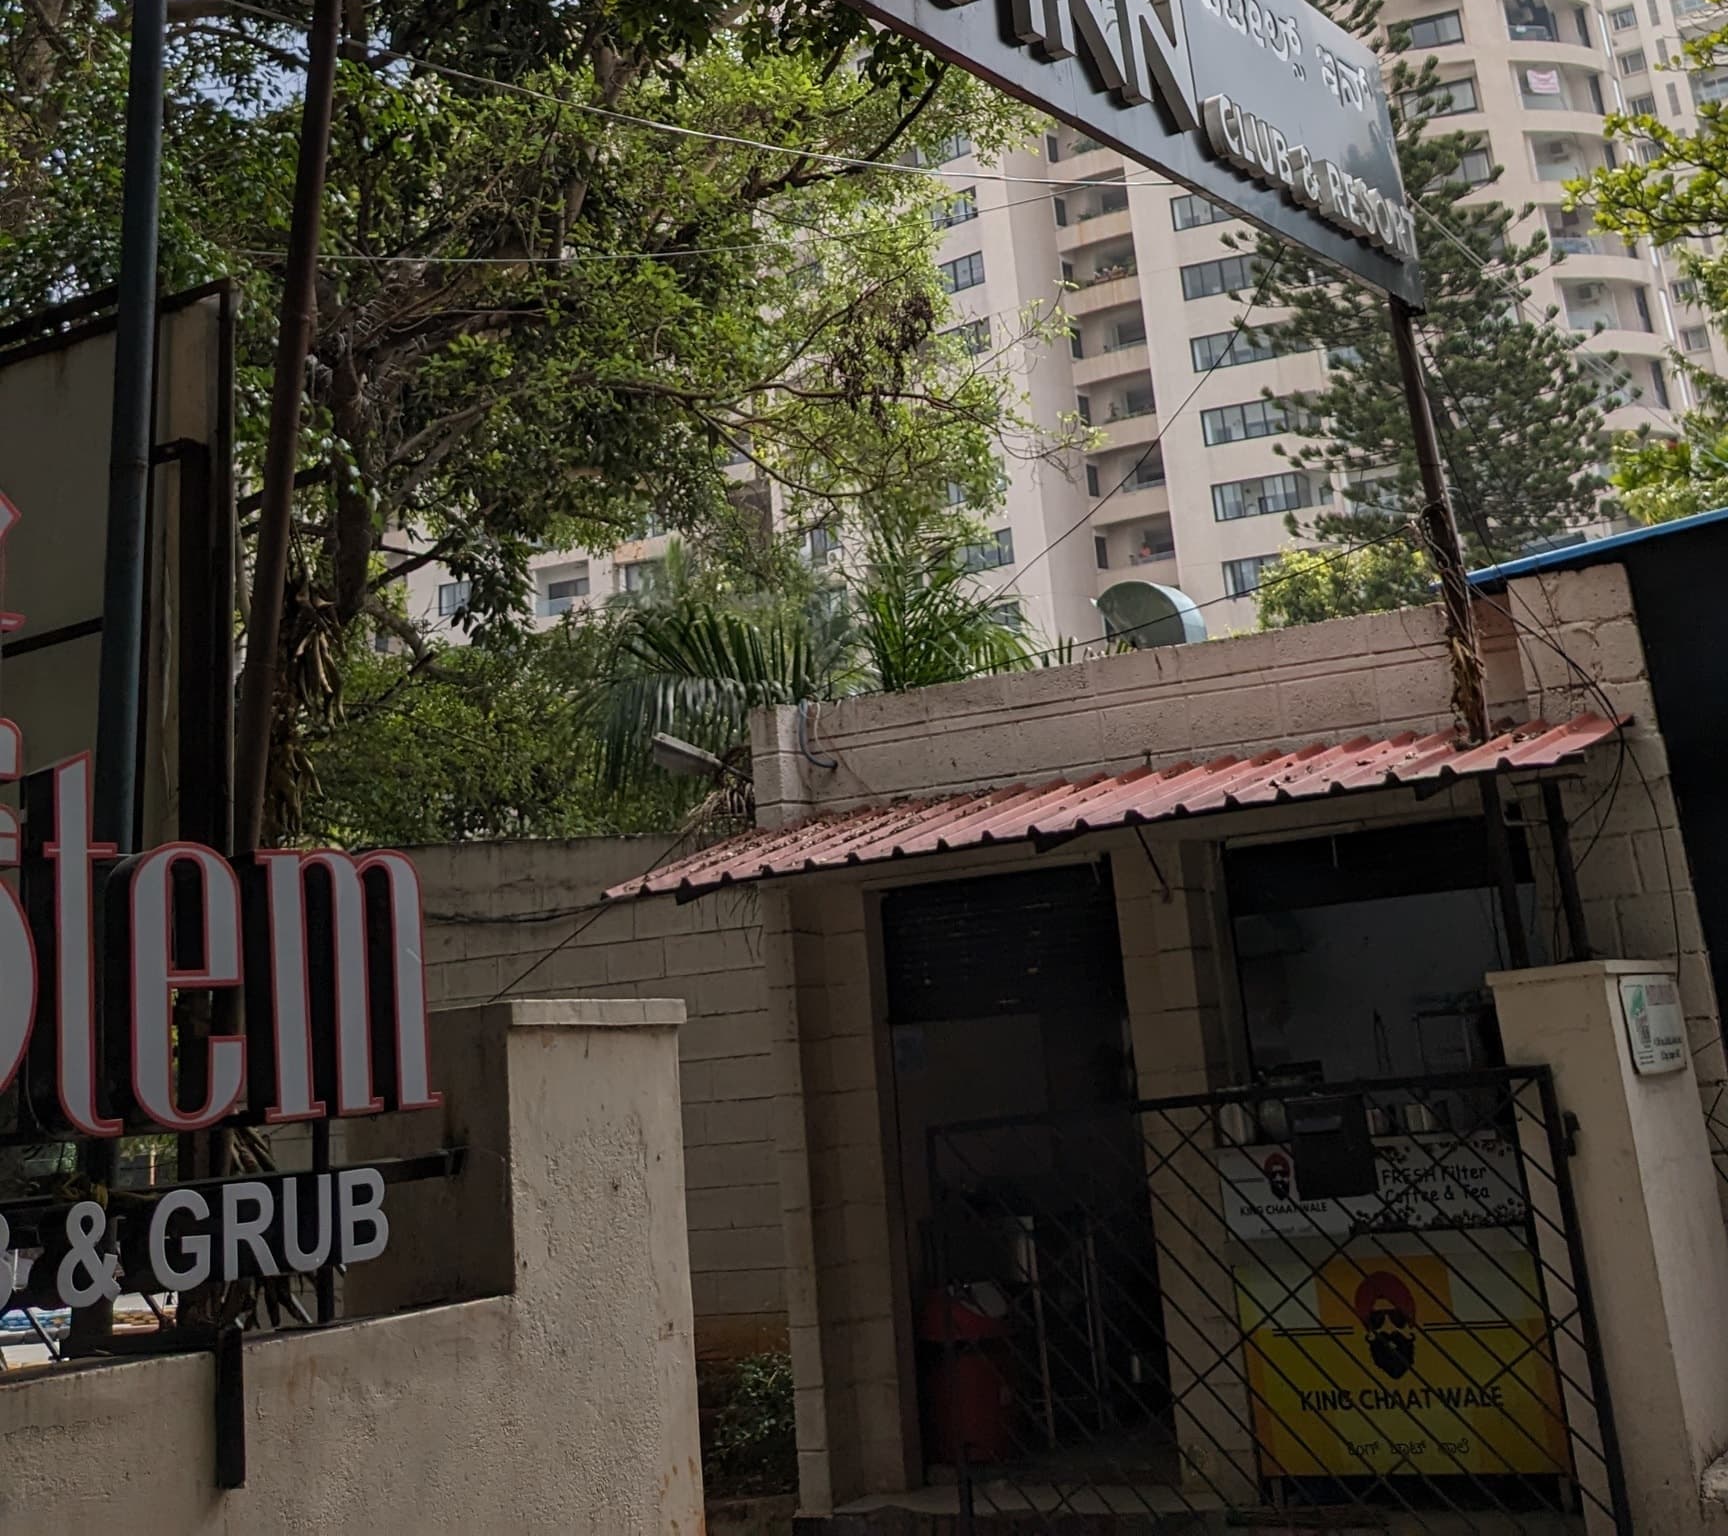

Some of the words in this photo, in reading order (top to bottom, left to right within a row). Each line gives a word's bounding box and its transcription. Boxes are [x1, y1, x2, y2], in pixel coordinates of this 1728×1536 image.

[1204, 93, 1294, 190] CLUB
[1289, 144, 1322, 209] &
[1317, 159, 1419, 262] RESORT
[1382, 1166, 1436, 1185] FRESH
[56, 1201, 122, 1308] &
[149, 1167, 391, 1292] GRUB
[1299, 1389, 1354, 1411] KING
